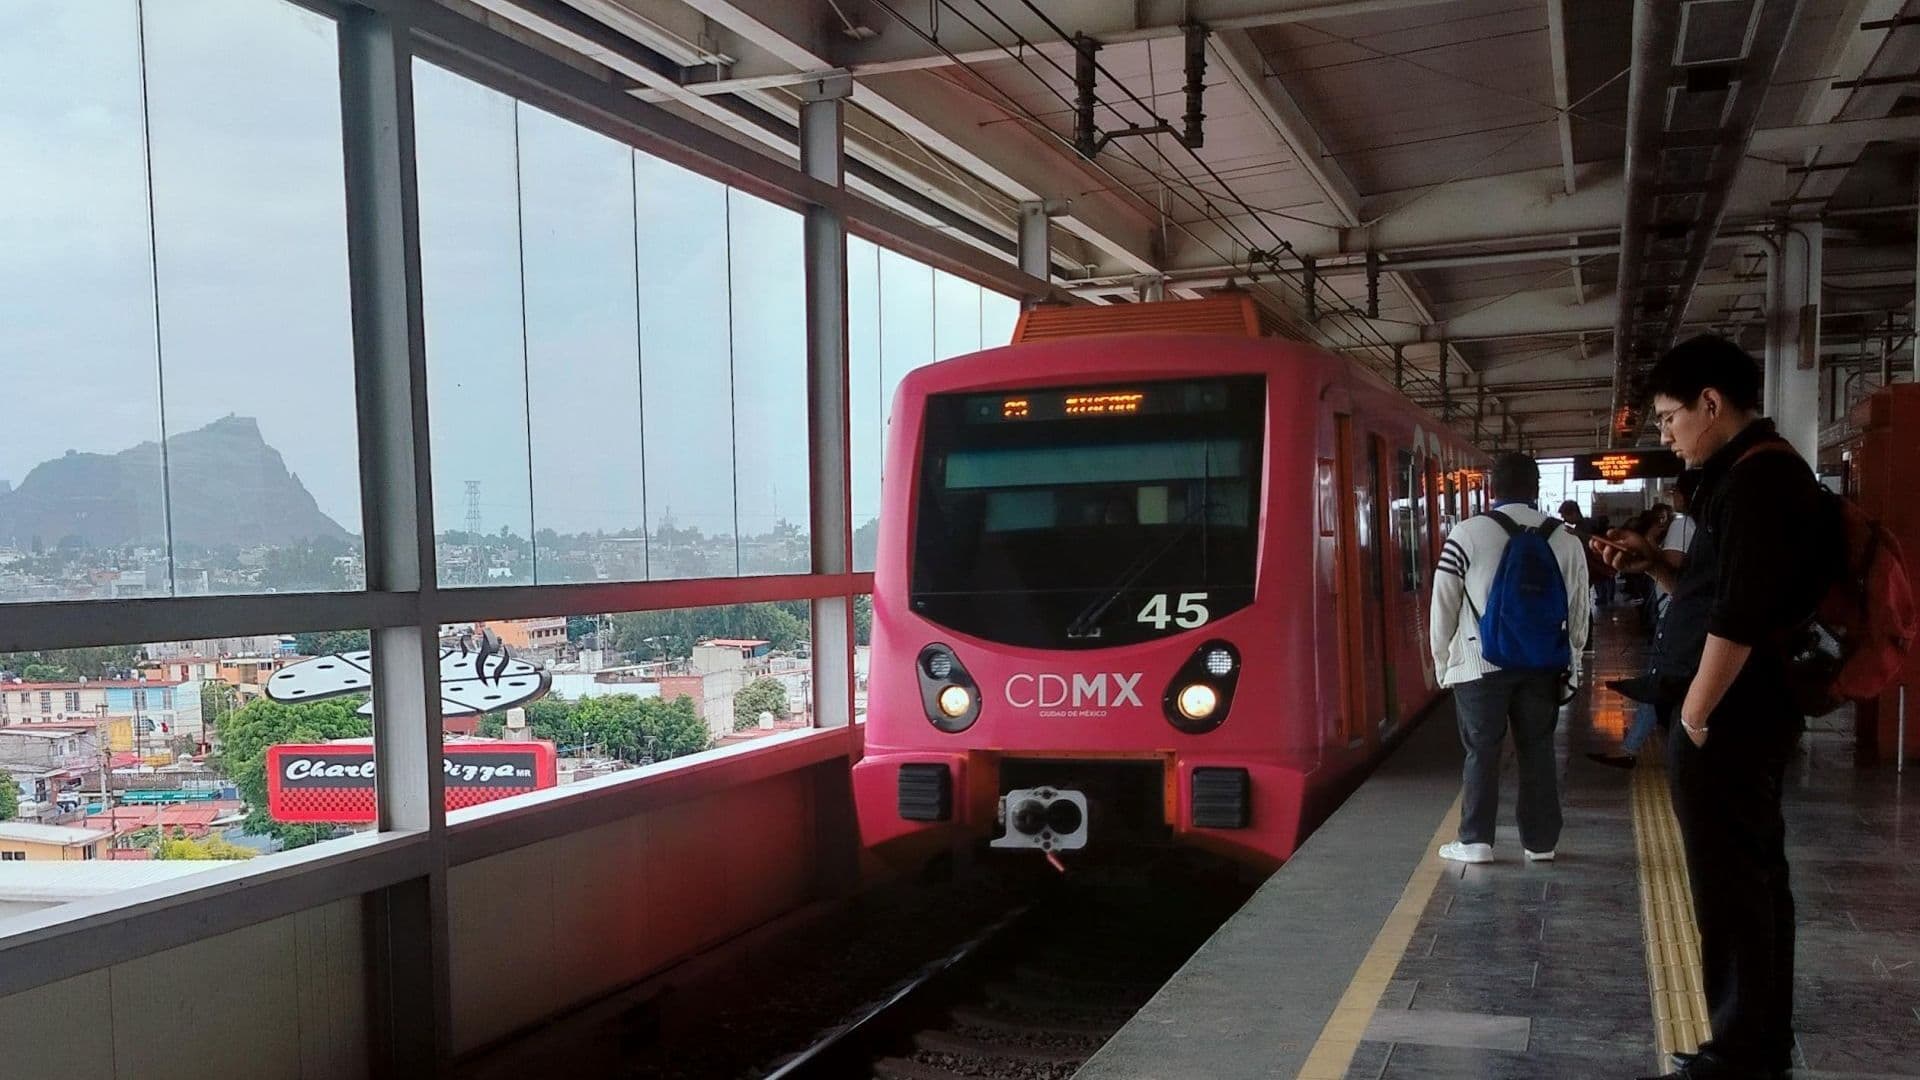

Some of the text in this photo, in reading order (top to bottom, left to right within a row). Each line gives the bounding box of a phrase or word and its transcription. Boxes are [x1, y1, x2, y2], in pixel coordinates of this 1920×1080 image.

[1137, 592, 1209, 629] 45
[1005, 673, 1144, 708] CDMX
[286, 759, 376, 780] Charl
[516, 769, 532, 777] MR
